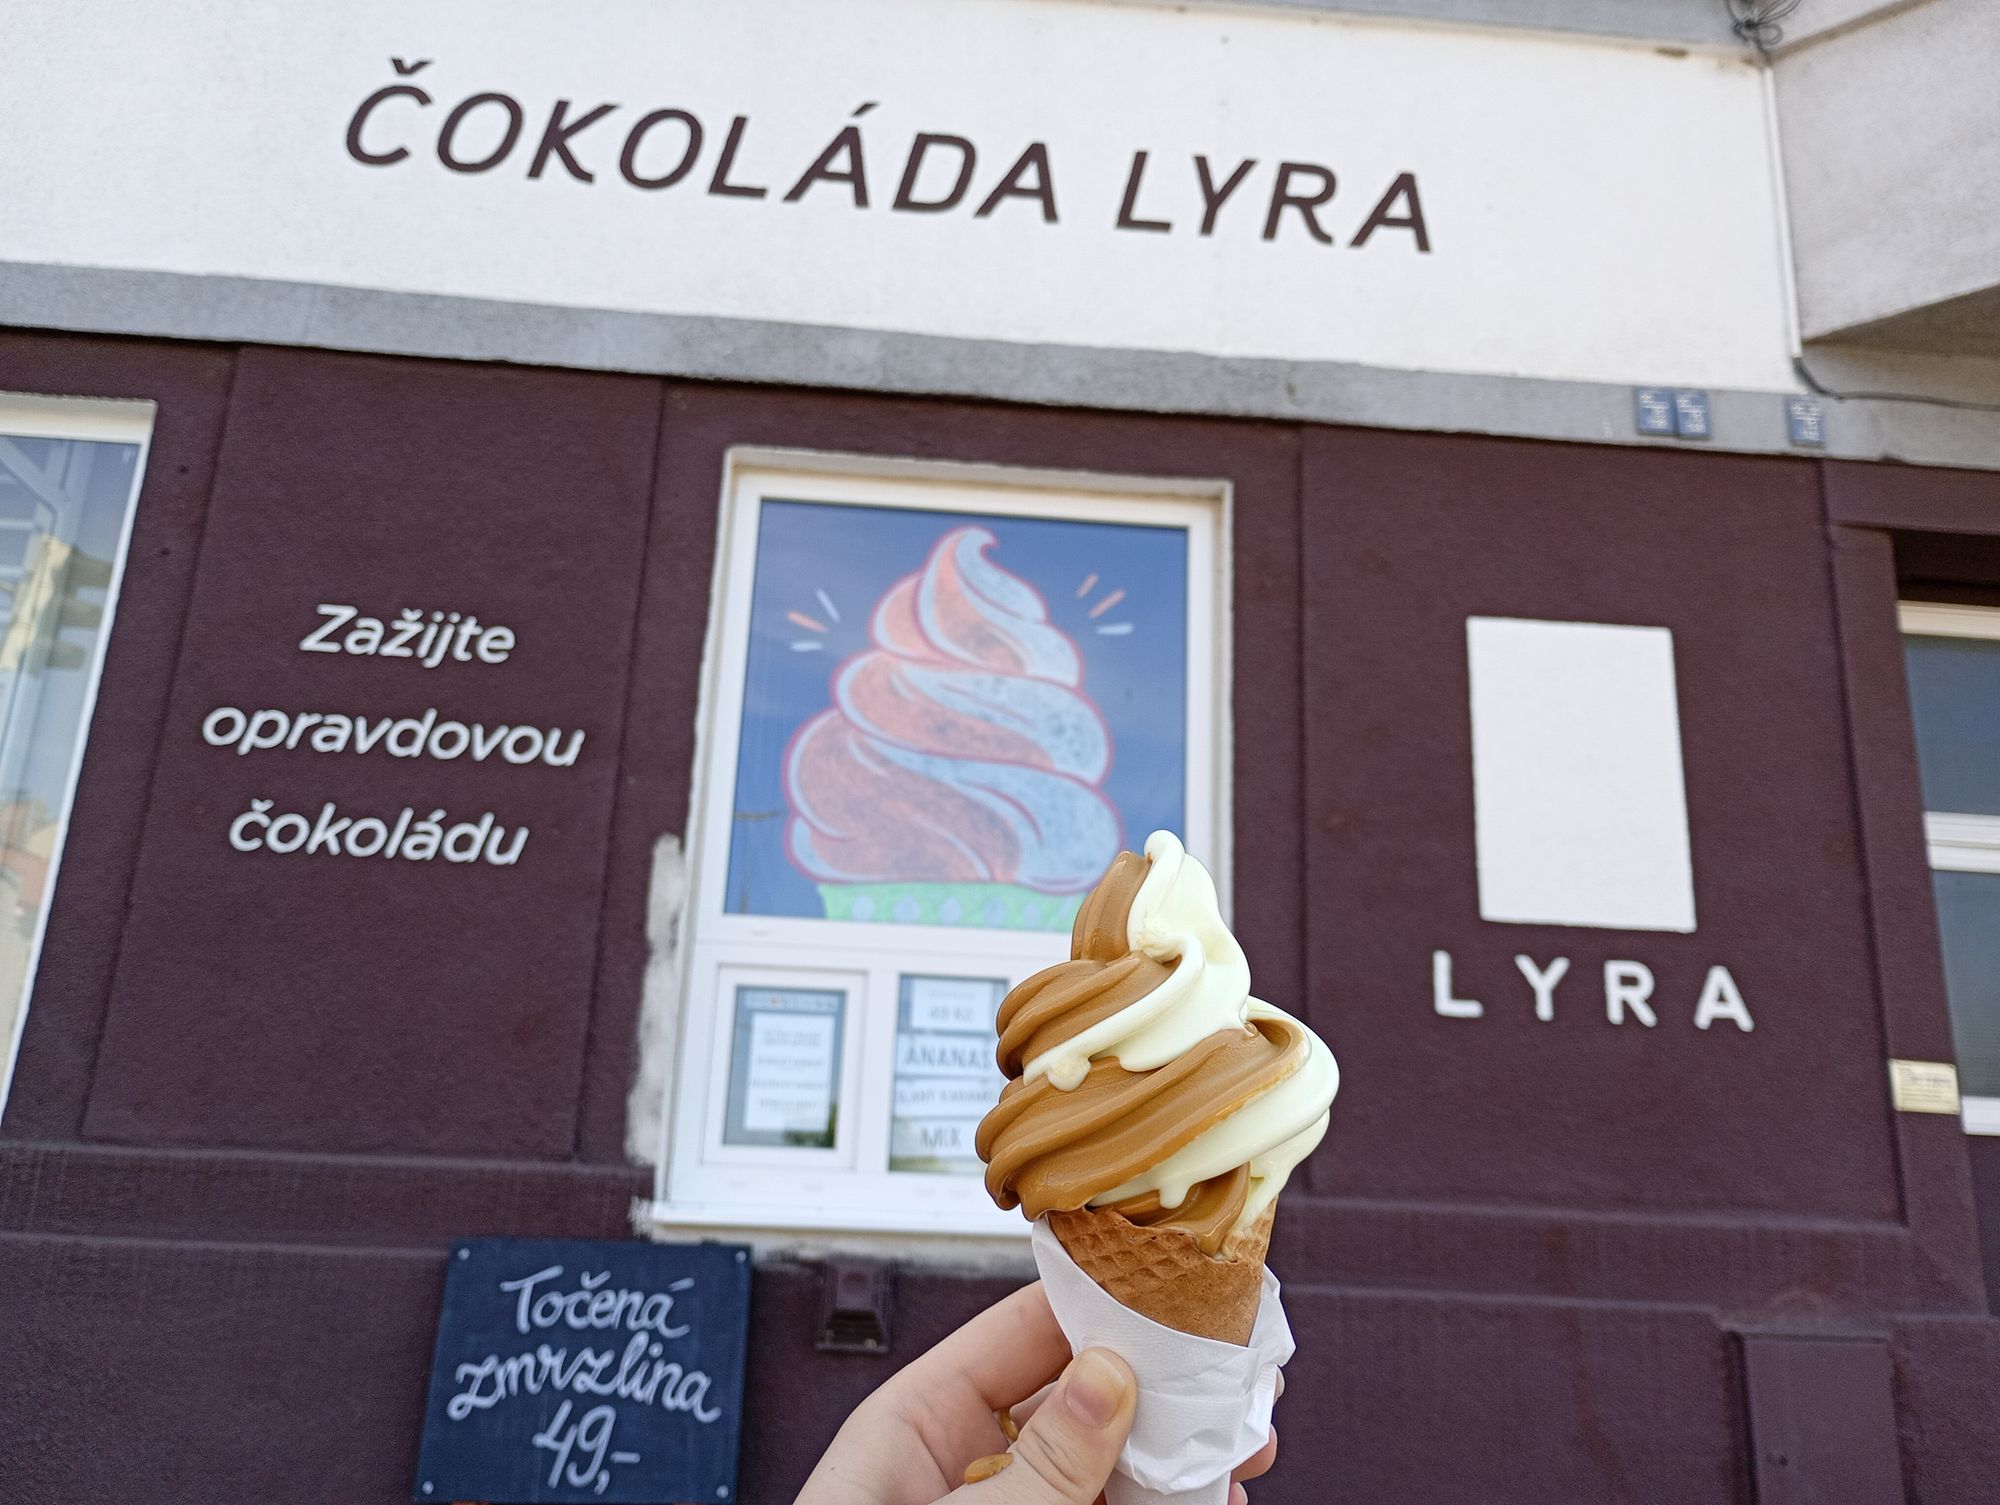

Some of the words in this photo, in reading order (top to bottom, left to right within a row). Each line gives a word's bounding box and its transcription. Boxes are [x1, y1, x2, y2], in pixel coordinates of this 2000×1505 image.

[345, 57, 1059, 223] ČOKOLÁDA
[1116, 150, 1431, 253] LYRA
[300, 603, 515, 668] Zažijte
[202, 707, 586, 766] opravdovou
[229, 798, 529, 865] čokoládu
[1433, 950, 1754, 1032] LYRA
[904, 1046, 993, 1070] ANANAS
[500, 1265, 695, 1338] Točená
[447, 1331, 722, 1422] zmrzlina
